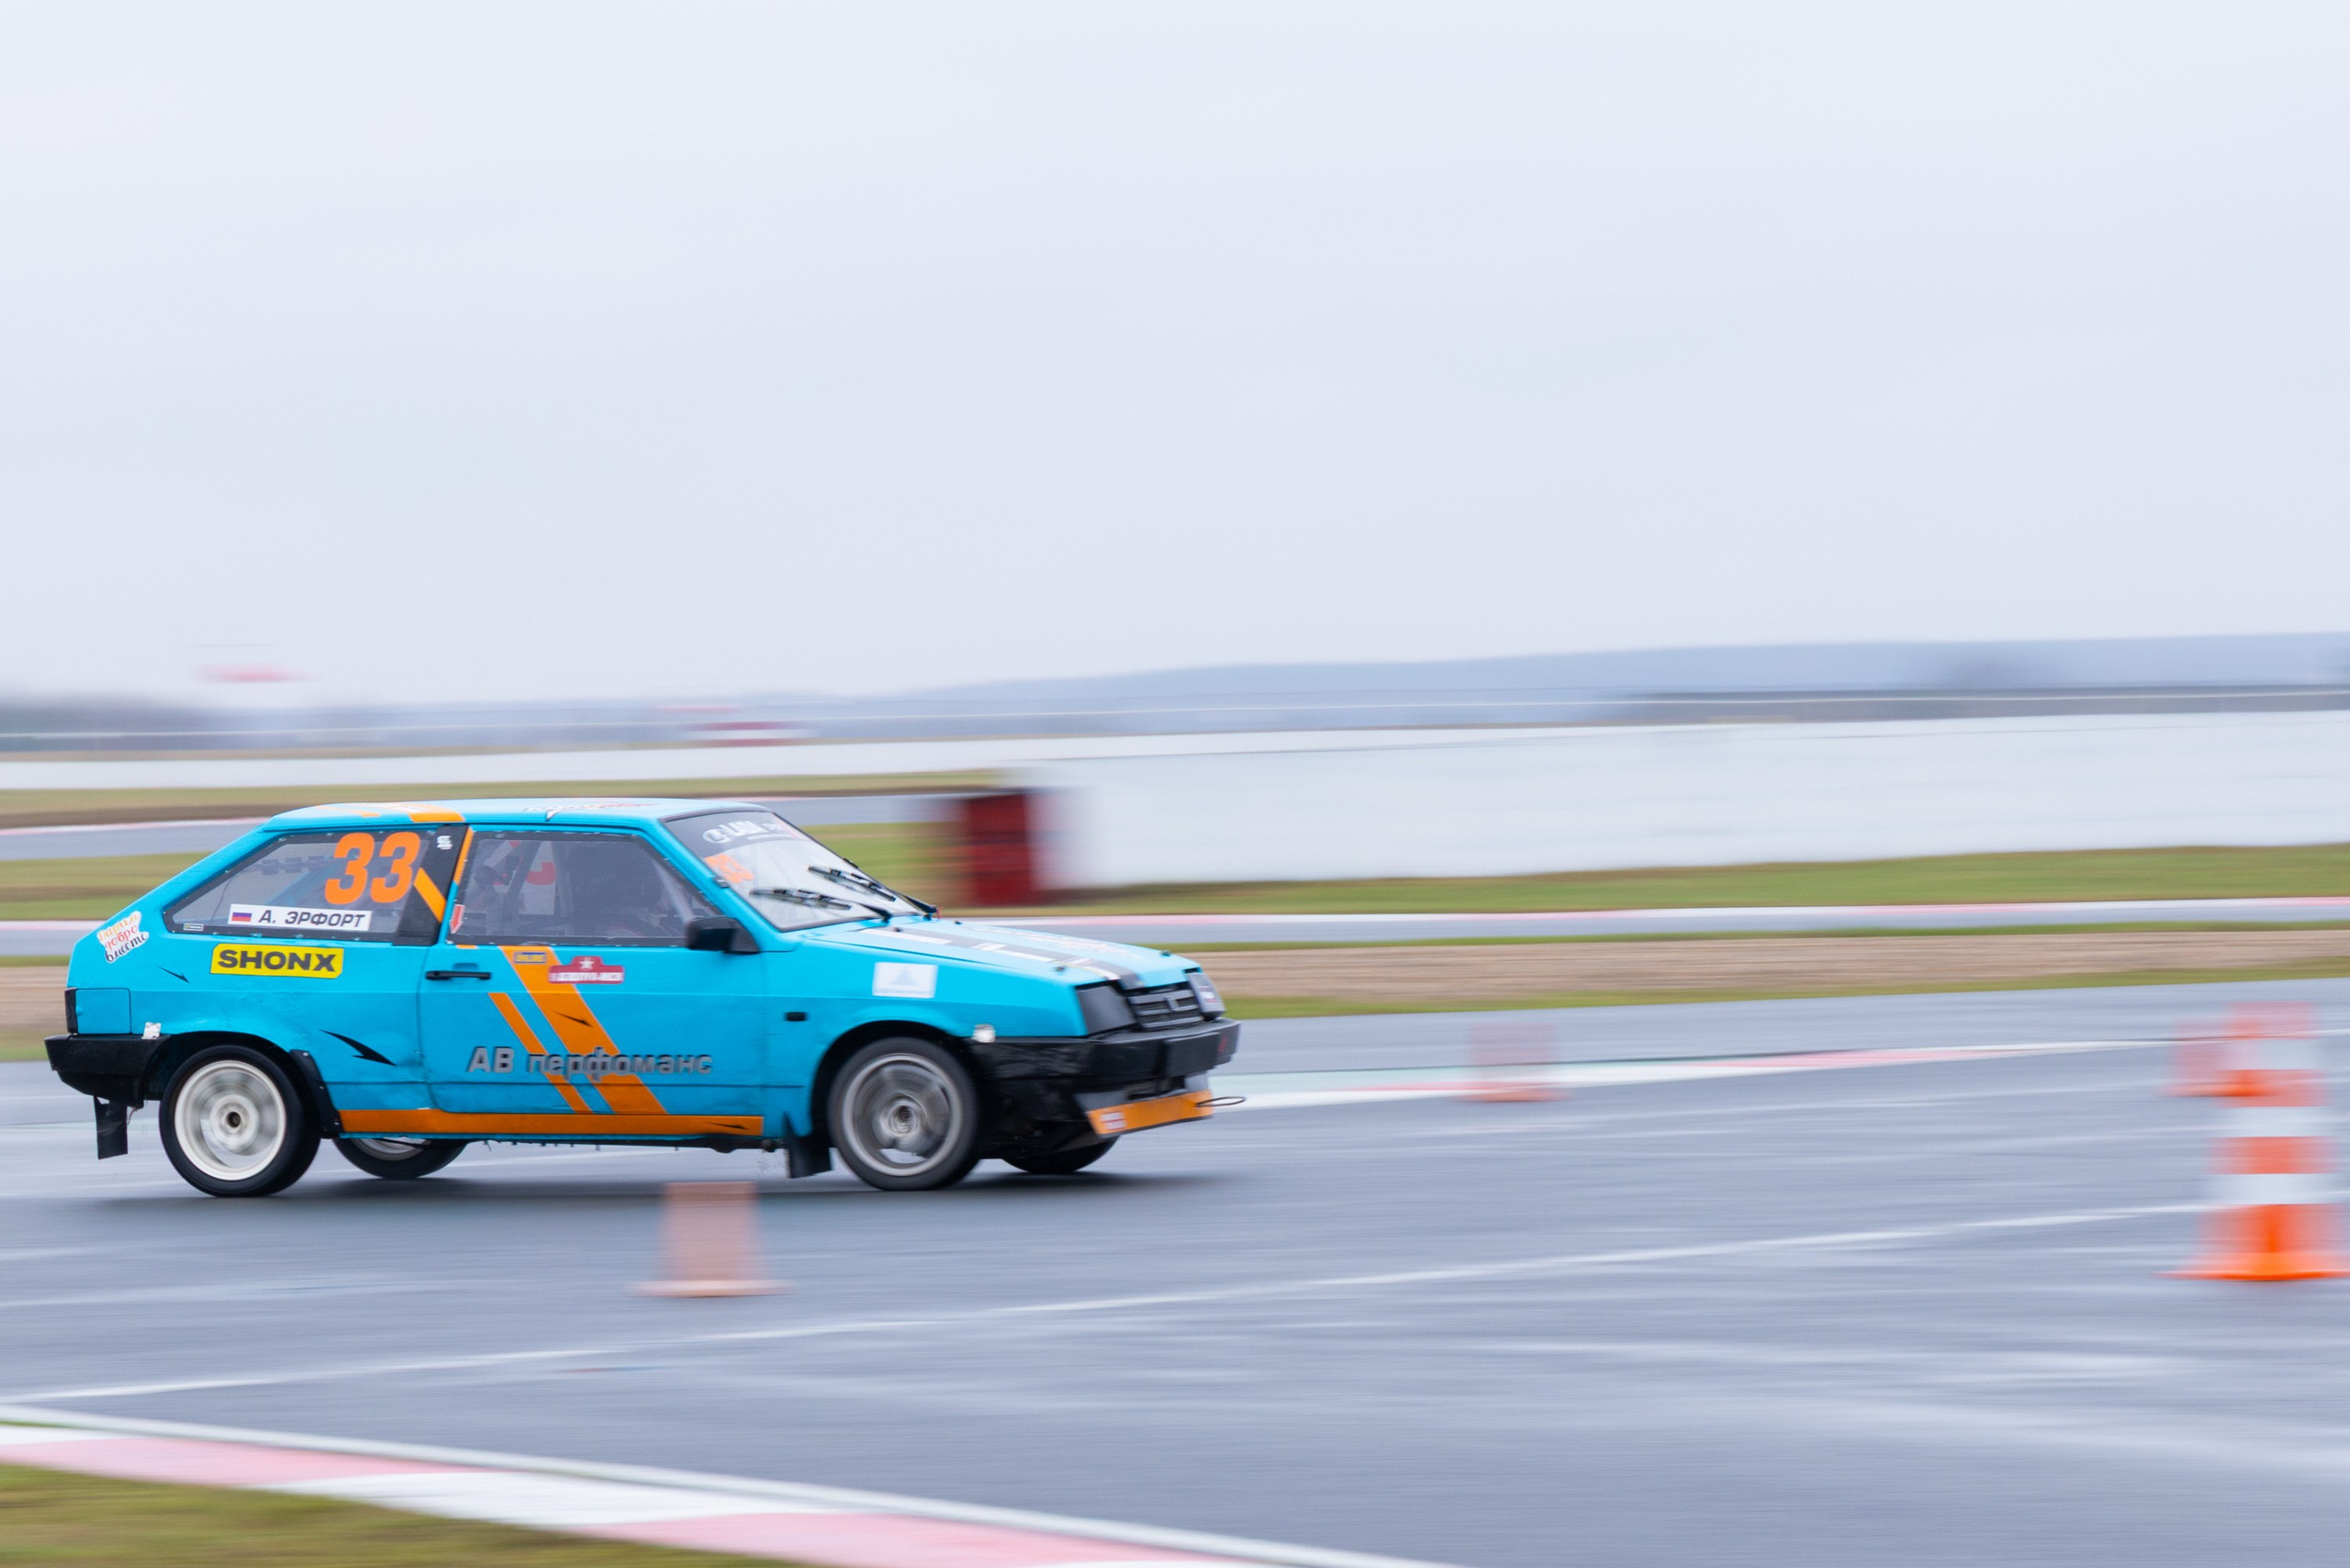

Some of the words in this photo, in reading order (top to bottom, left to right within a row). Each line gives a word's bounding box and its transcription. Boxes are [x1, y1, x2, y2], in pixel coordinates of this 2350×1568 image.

[324, 832, 421, 904] 33
[259, 909, 276, 924] А.
[285, 911, 366, 928] ЭРФОРТ
[105, 924, 138, 953] добро
[218, 948, 336, 973] SHONX
[528, 1046, 713, 1083] перфоманс
